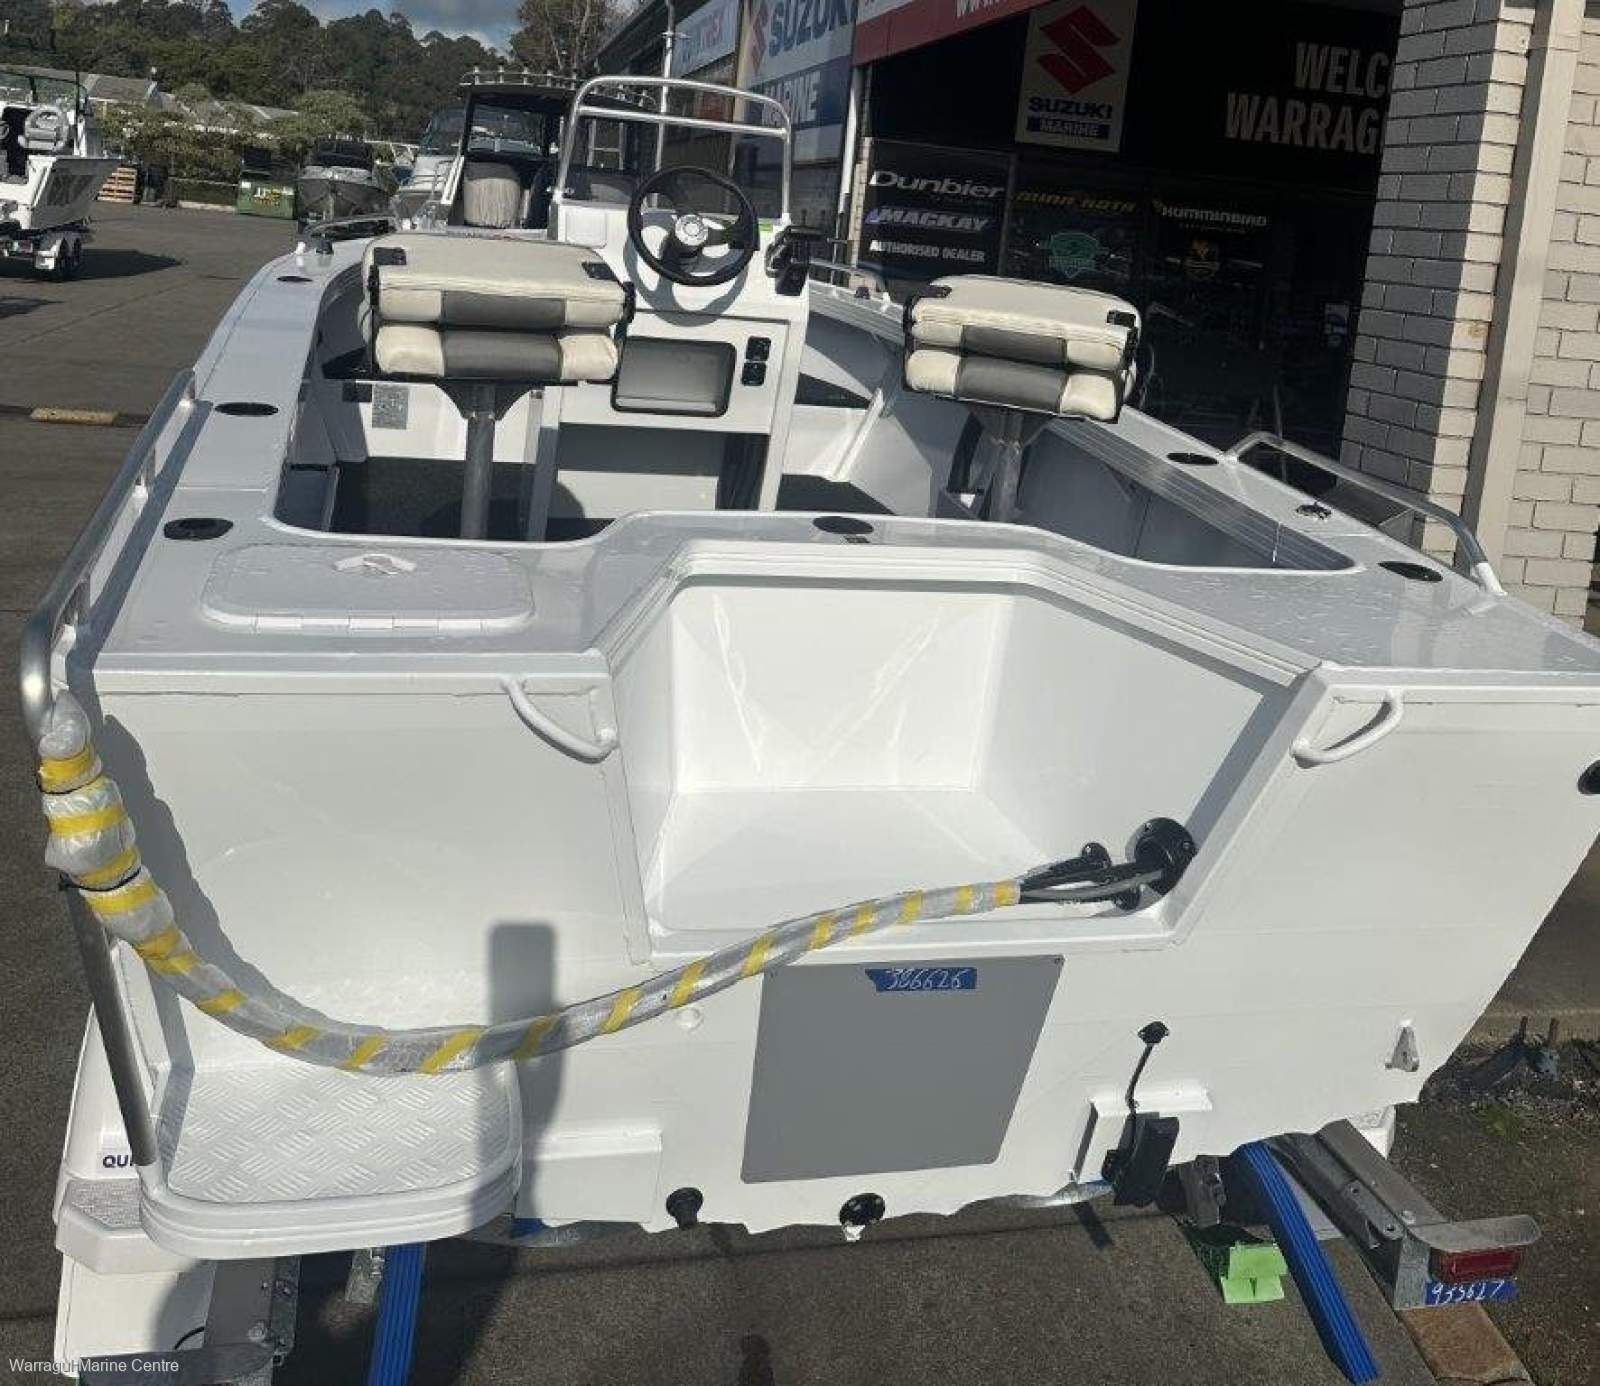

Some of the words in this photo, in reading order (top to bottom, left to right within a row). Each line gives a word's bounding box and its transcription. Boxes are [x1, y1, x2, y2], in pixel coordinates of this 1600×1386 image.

[1294, 42, 1391, 98] WELC
[1028, 97, 1112, 119] SUZUKI
[1224, 93, 1384, 155] WARRAG
[868, 170, 1006, 198] Dunbier
[878, 208, 989, 232] MACKAY
